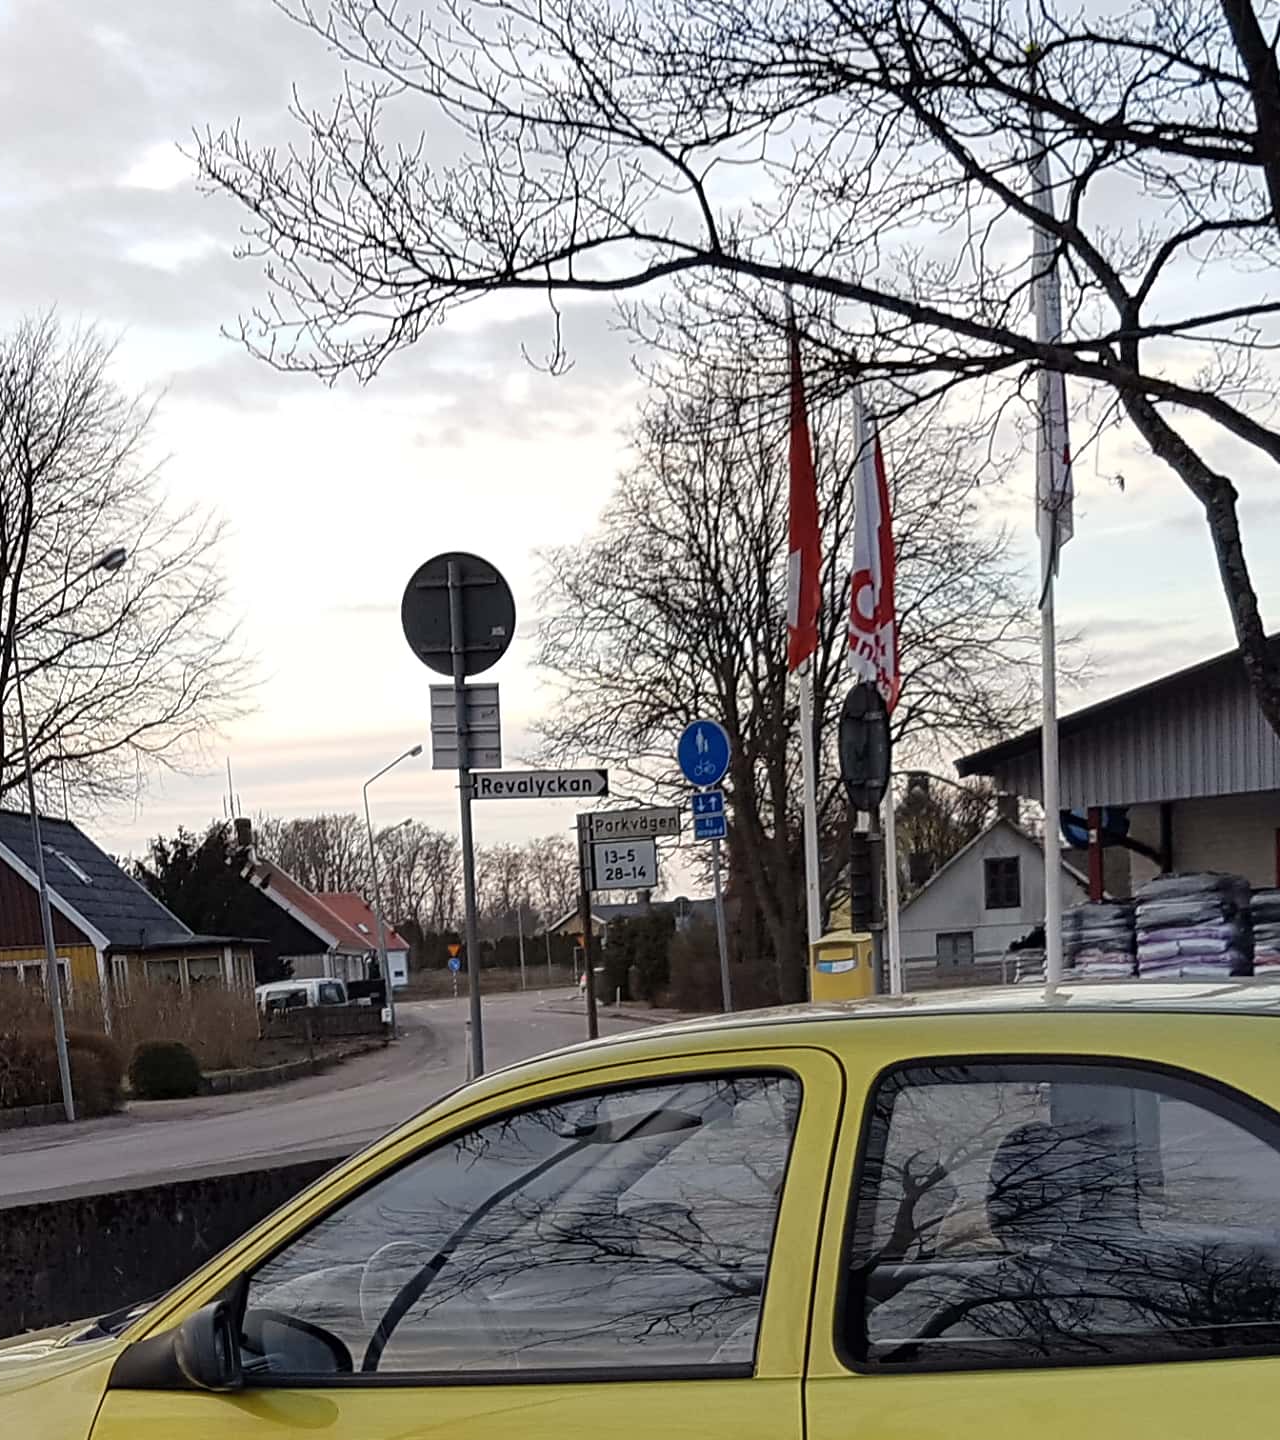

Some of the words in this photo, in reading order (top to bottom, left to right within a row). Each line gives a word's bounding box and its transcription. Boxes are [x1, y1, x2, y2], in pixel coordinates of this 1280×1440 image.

[481, 776, 592, 798] Revalyckan
[595, 816, 677, 832] Parkvägen
[604, 849, 636, 864] 13-5
[605, 865, 647, 881] 28-14
